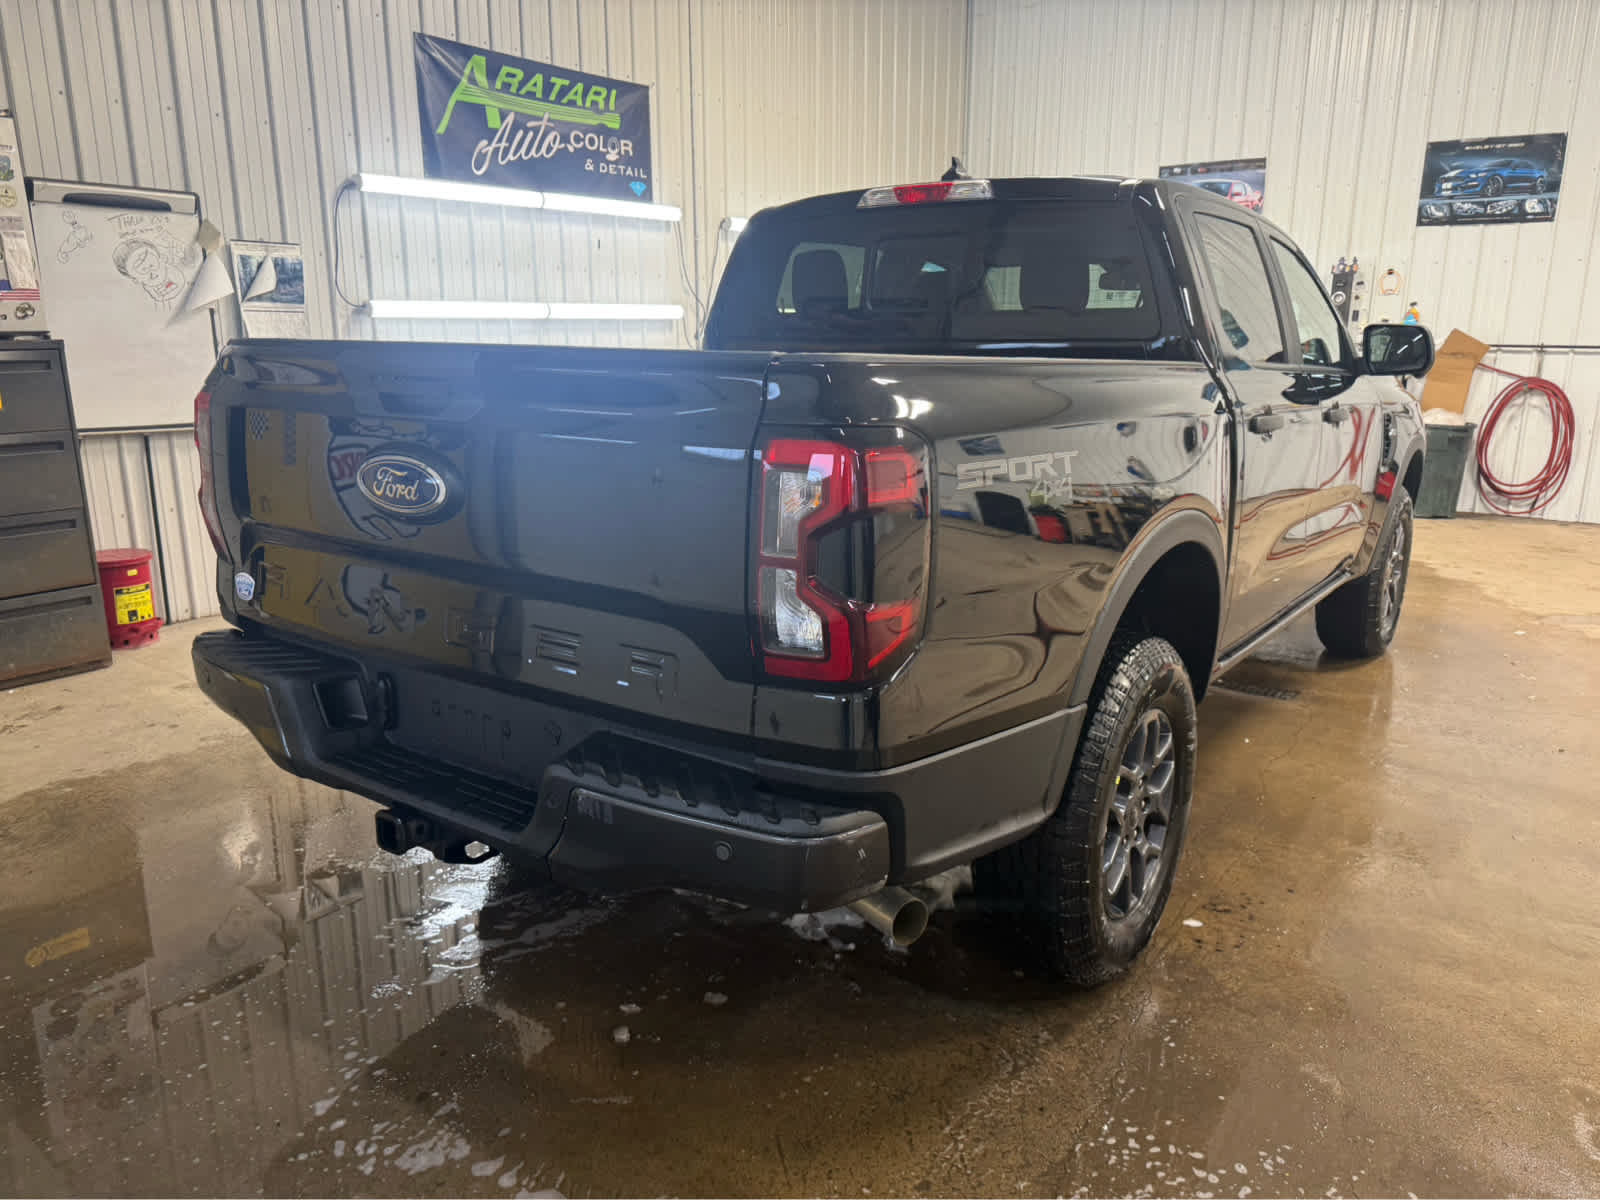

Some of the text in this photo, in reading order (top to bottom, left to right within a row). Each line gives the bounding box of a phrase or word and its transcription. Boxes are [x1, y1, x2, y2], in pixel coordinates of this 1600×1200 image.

[436, 54, 621, 134] ARATARI
[471, 111, 633, 176] Auto COLOR
[584, 159, 648, 179] & DETAIL
[372, 466, 420, 501] Ford
[956, 450, 1079, 490] SPORT
